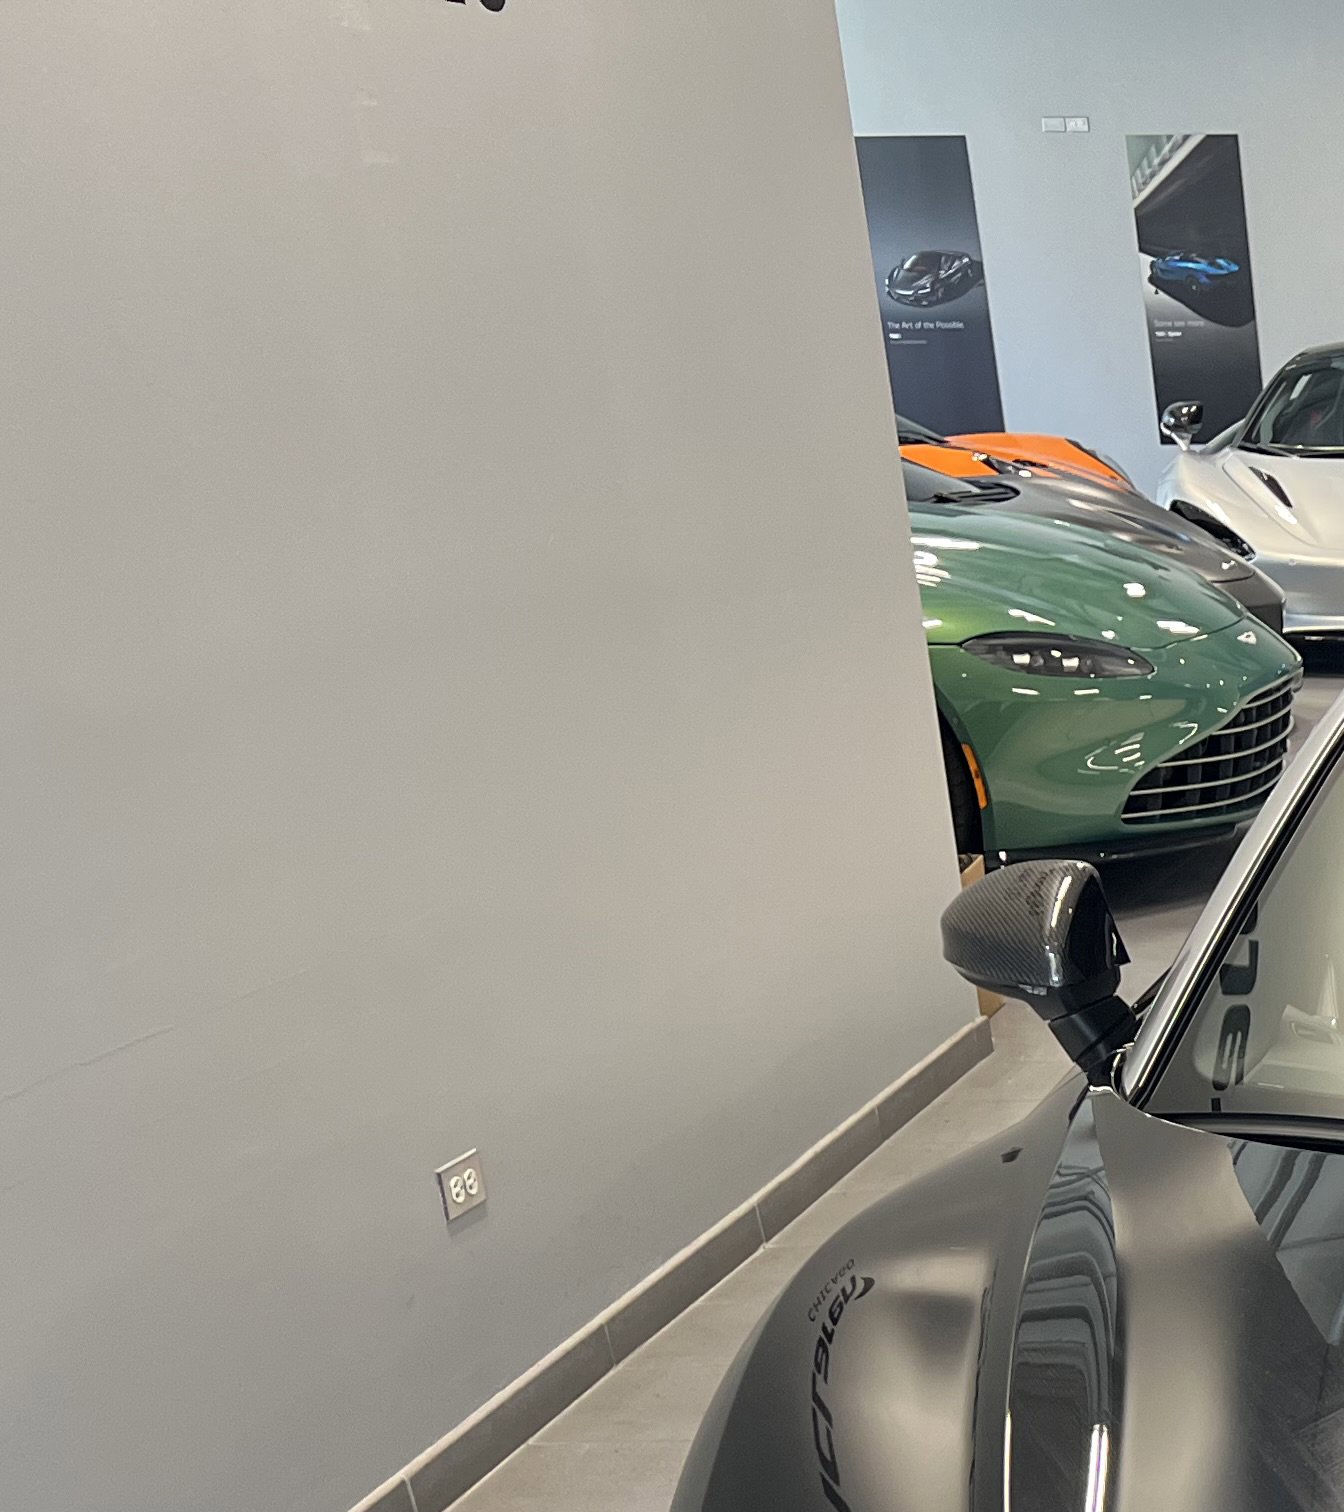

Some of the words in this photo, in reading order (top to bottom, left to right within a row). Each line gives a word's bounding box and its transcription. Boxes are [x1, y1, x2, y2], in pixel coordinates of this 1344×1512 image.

[887, 321, 900, 329] The
[901, 321, 913, 329] Art
[914, 321, 922, 329] of
[923, 321, 935, 329] the
